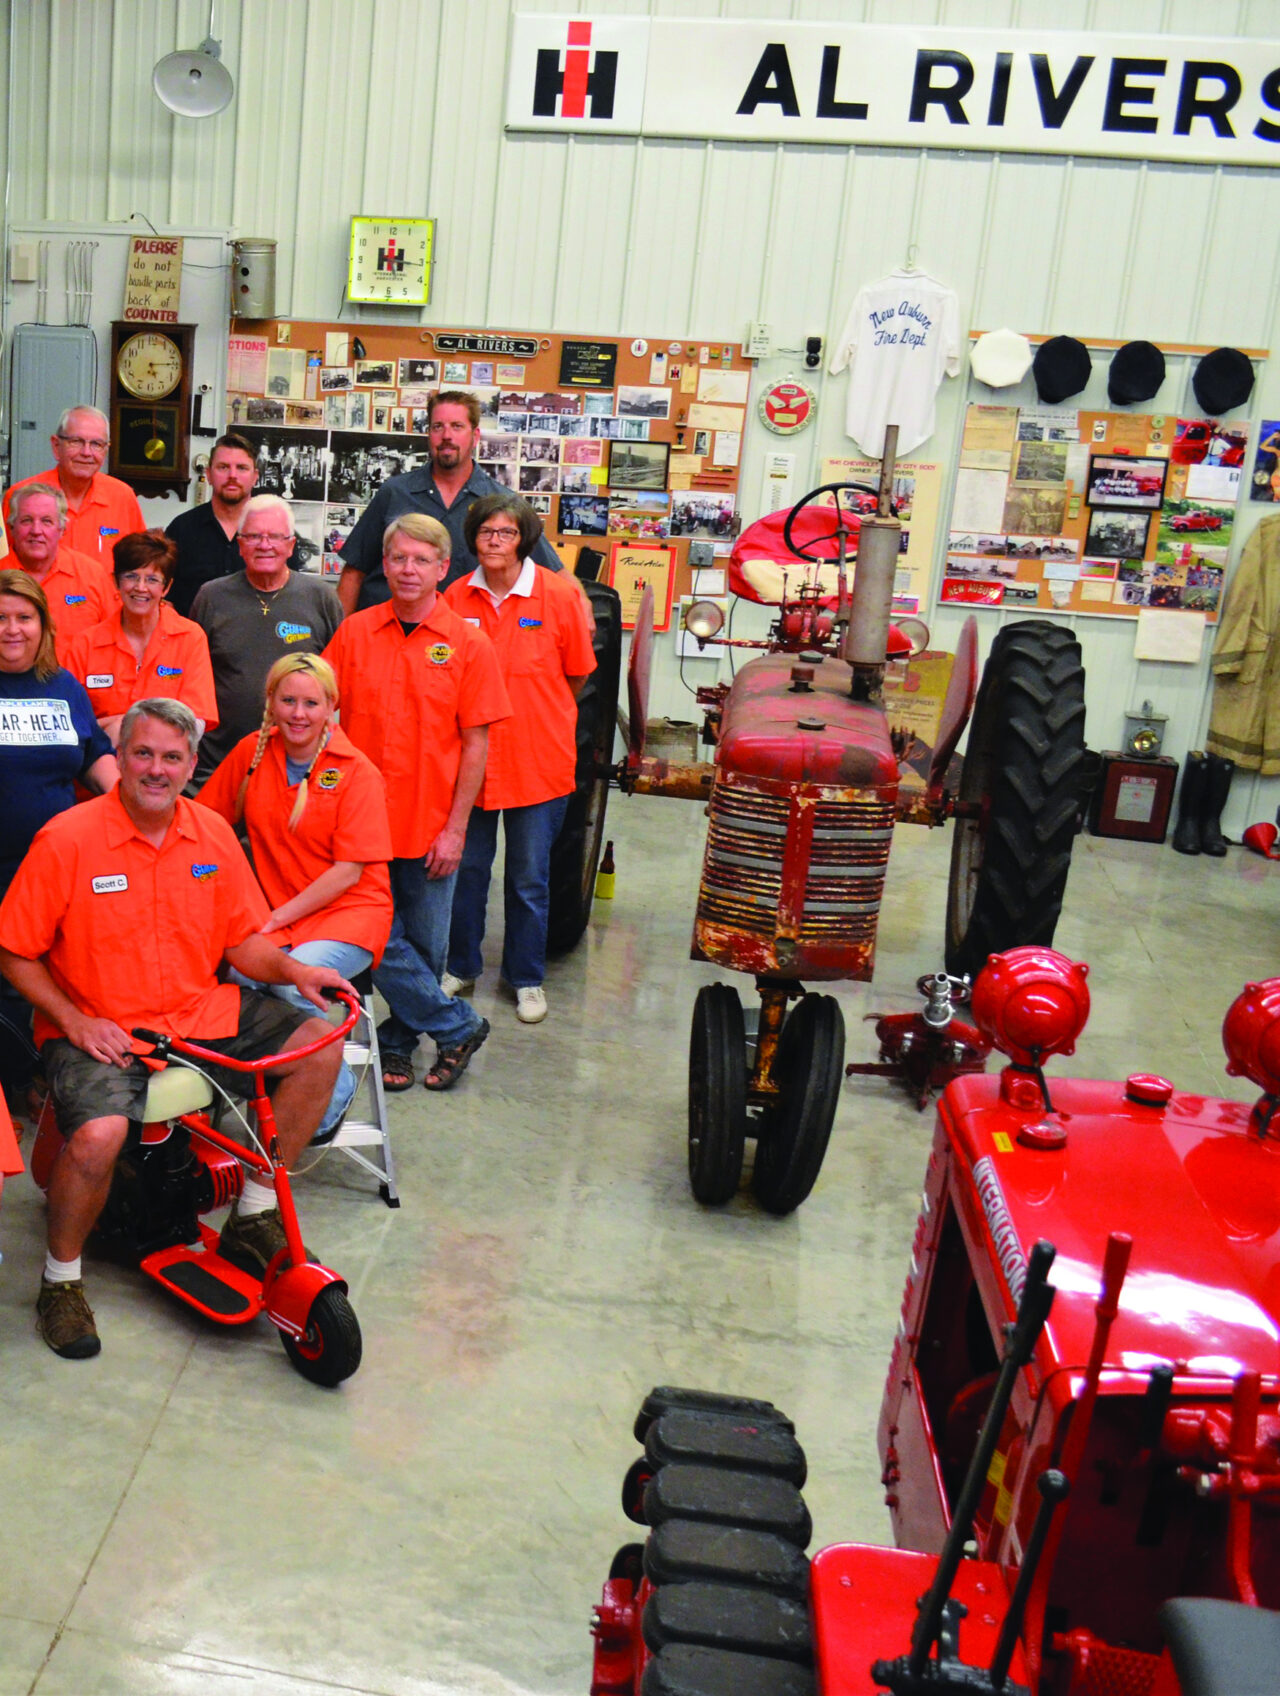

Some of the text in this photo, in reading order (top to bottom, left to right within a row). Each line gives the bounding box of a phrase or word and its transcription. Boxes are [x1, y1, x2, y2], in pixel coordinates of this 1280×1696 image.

[735, 43, 869, 120] AL
[373, 226, 379, 234] 11
[390, 227, 398, 236] 12
[408, 228, 411, 236] 1
[133, 239, 178, 255] PLEASE
[359, 238, 367, 246] 10
[420, 241, 425, 249] 2
[134, 257, 171, 271] do not
[129, 274, 176, 292] handle parts
[370, 286, 375, 294] 7
[386, 287, 391, 295] 6
[402, 288, 407, 296] 5
[161, 296, 171, 308] of
[125, 307, 178, 323] COUNTER
[869, 301, 932, 330] New Auburn
[874, 330, 898, 346] Fire
[458, 339, 515, 352] AL RIVERS
[947, 582, 965, 597] NEW
[0, 732, 58, 742] GET TOGETHER
[95, 877, 116, 890] Scott
[973, 1156, 1028, 1306] INTERNATION
